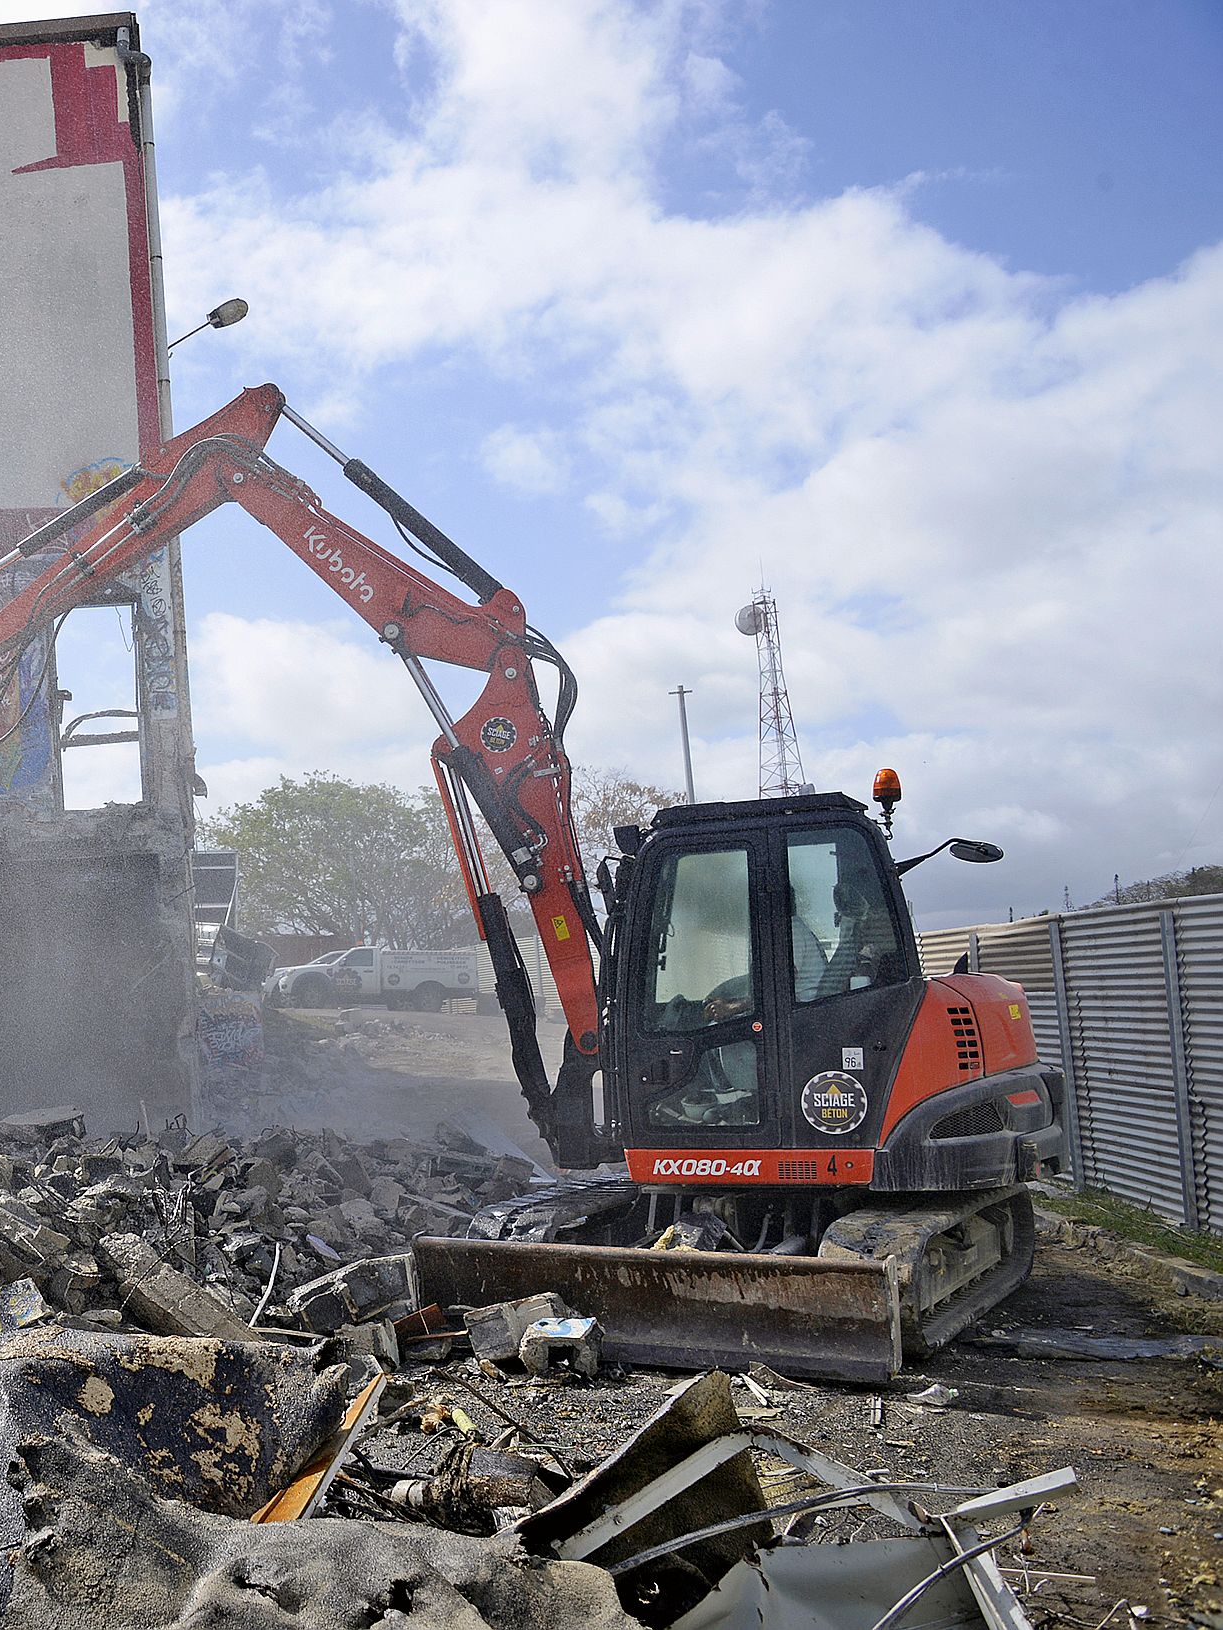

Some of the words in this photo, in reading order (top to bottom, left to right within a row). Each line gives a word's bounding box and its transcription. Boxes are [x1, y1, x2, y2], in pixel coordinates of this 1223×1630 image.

[303, 526, 374, 603] Kubota
[487, 727, 511, 740] SCIAGE
[844, 1056, 857, 1068] 96
[813, 1092, 856, 1107] SCIAGE
[826, 1155, 838, 1176] 4
